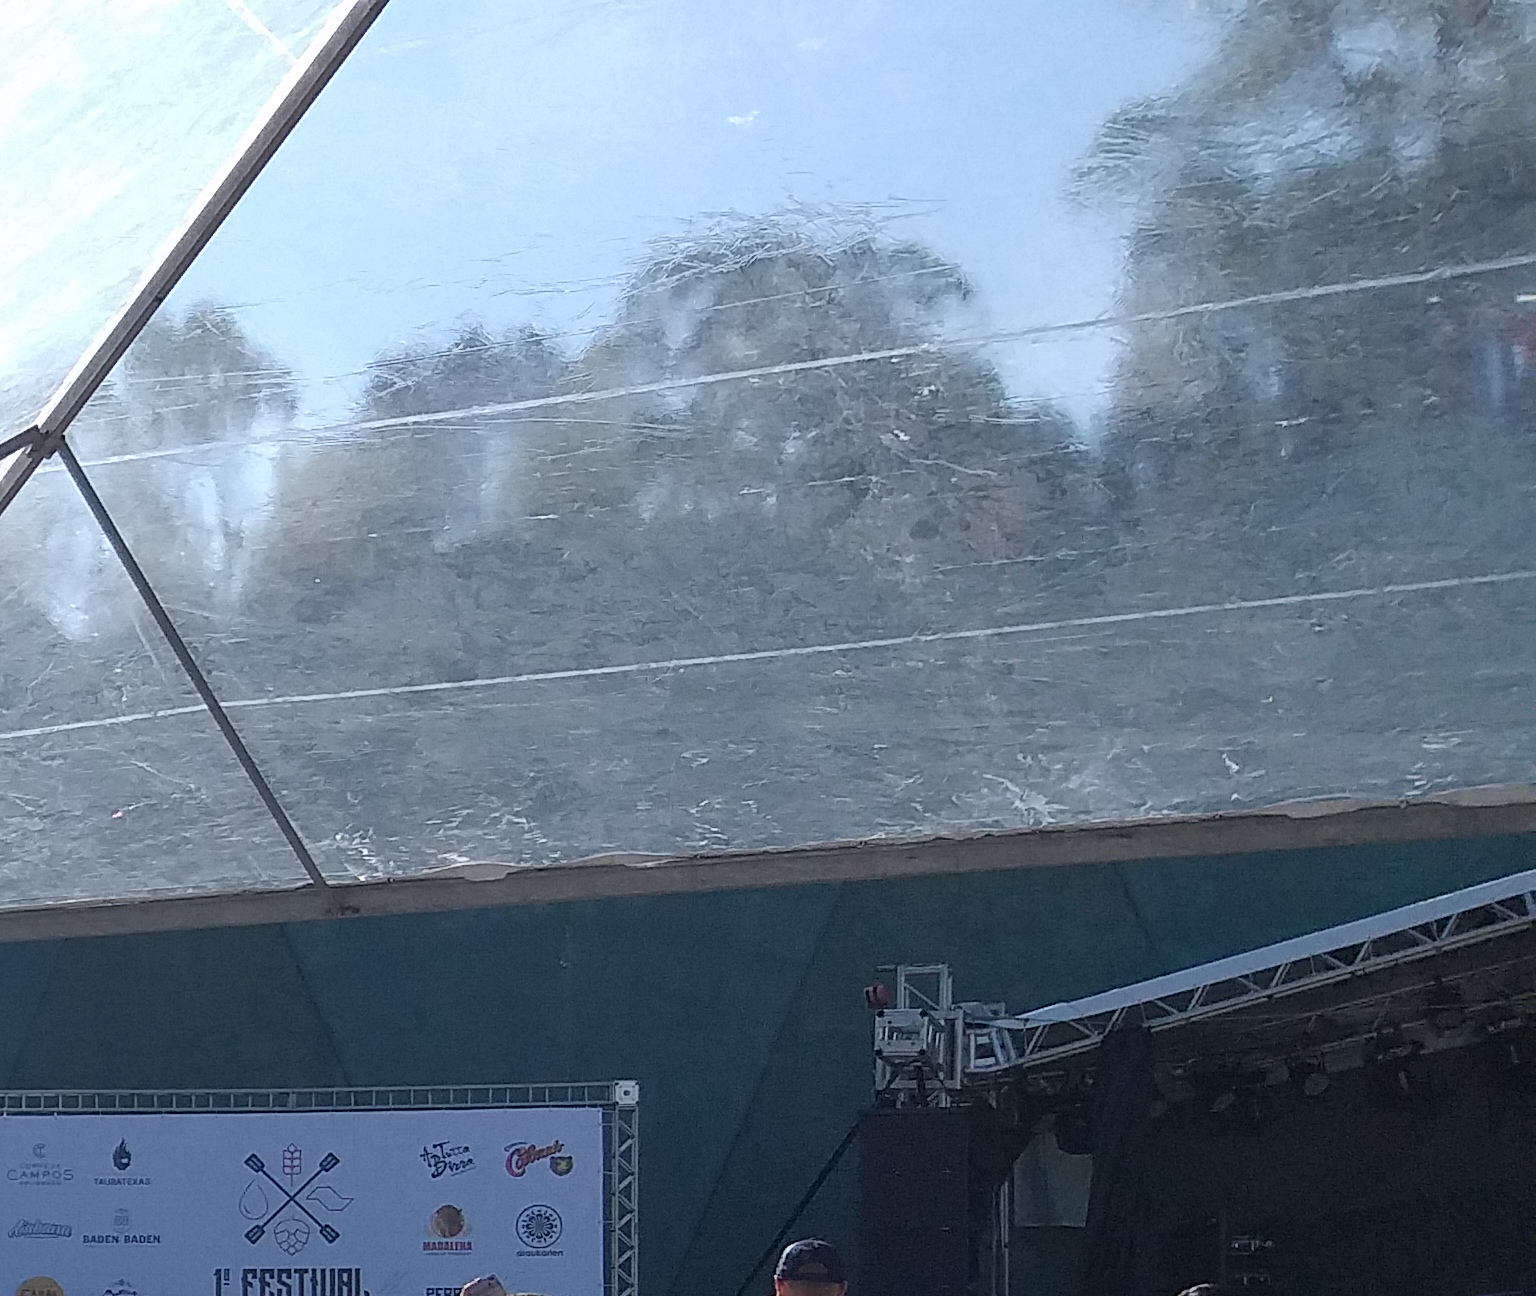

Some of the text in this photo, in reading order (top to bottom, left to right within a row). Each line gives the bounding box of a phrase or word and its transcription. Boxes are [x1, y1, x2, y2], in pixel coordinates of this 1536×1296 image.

[6, 1169, 74, 1181] CAMPOS
[93, 1177, 151, 1186] TAUBATEXAS
[82, 1234, 161, 1244] BADEN BADEN
